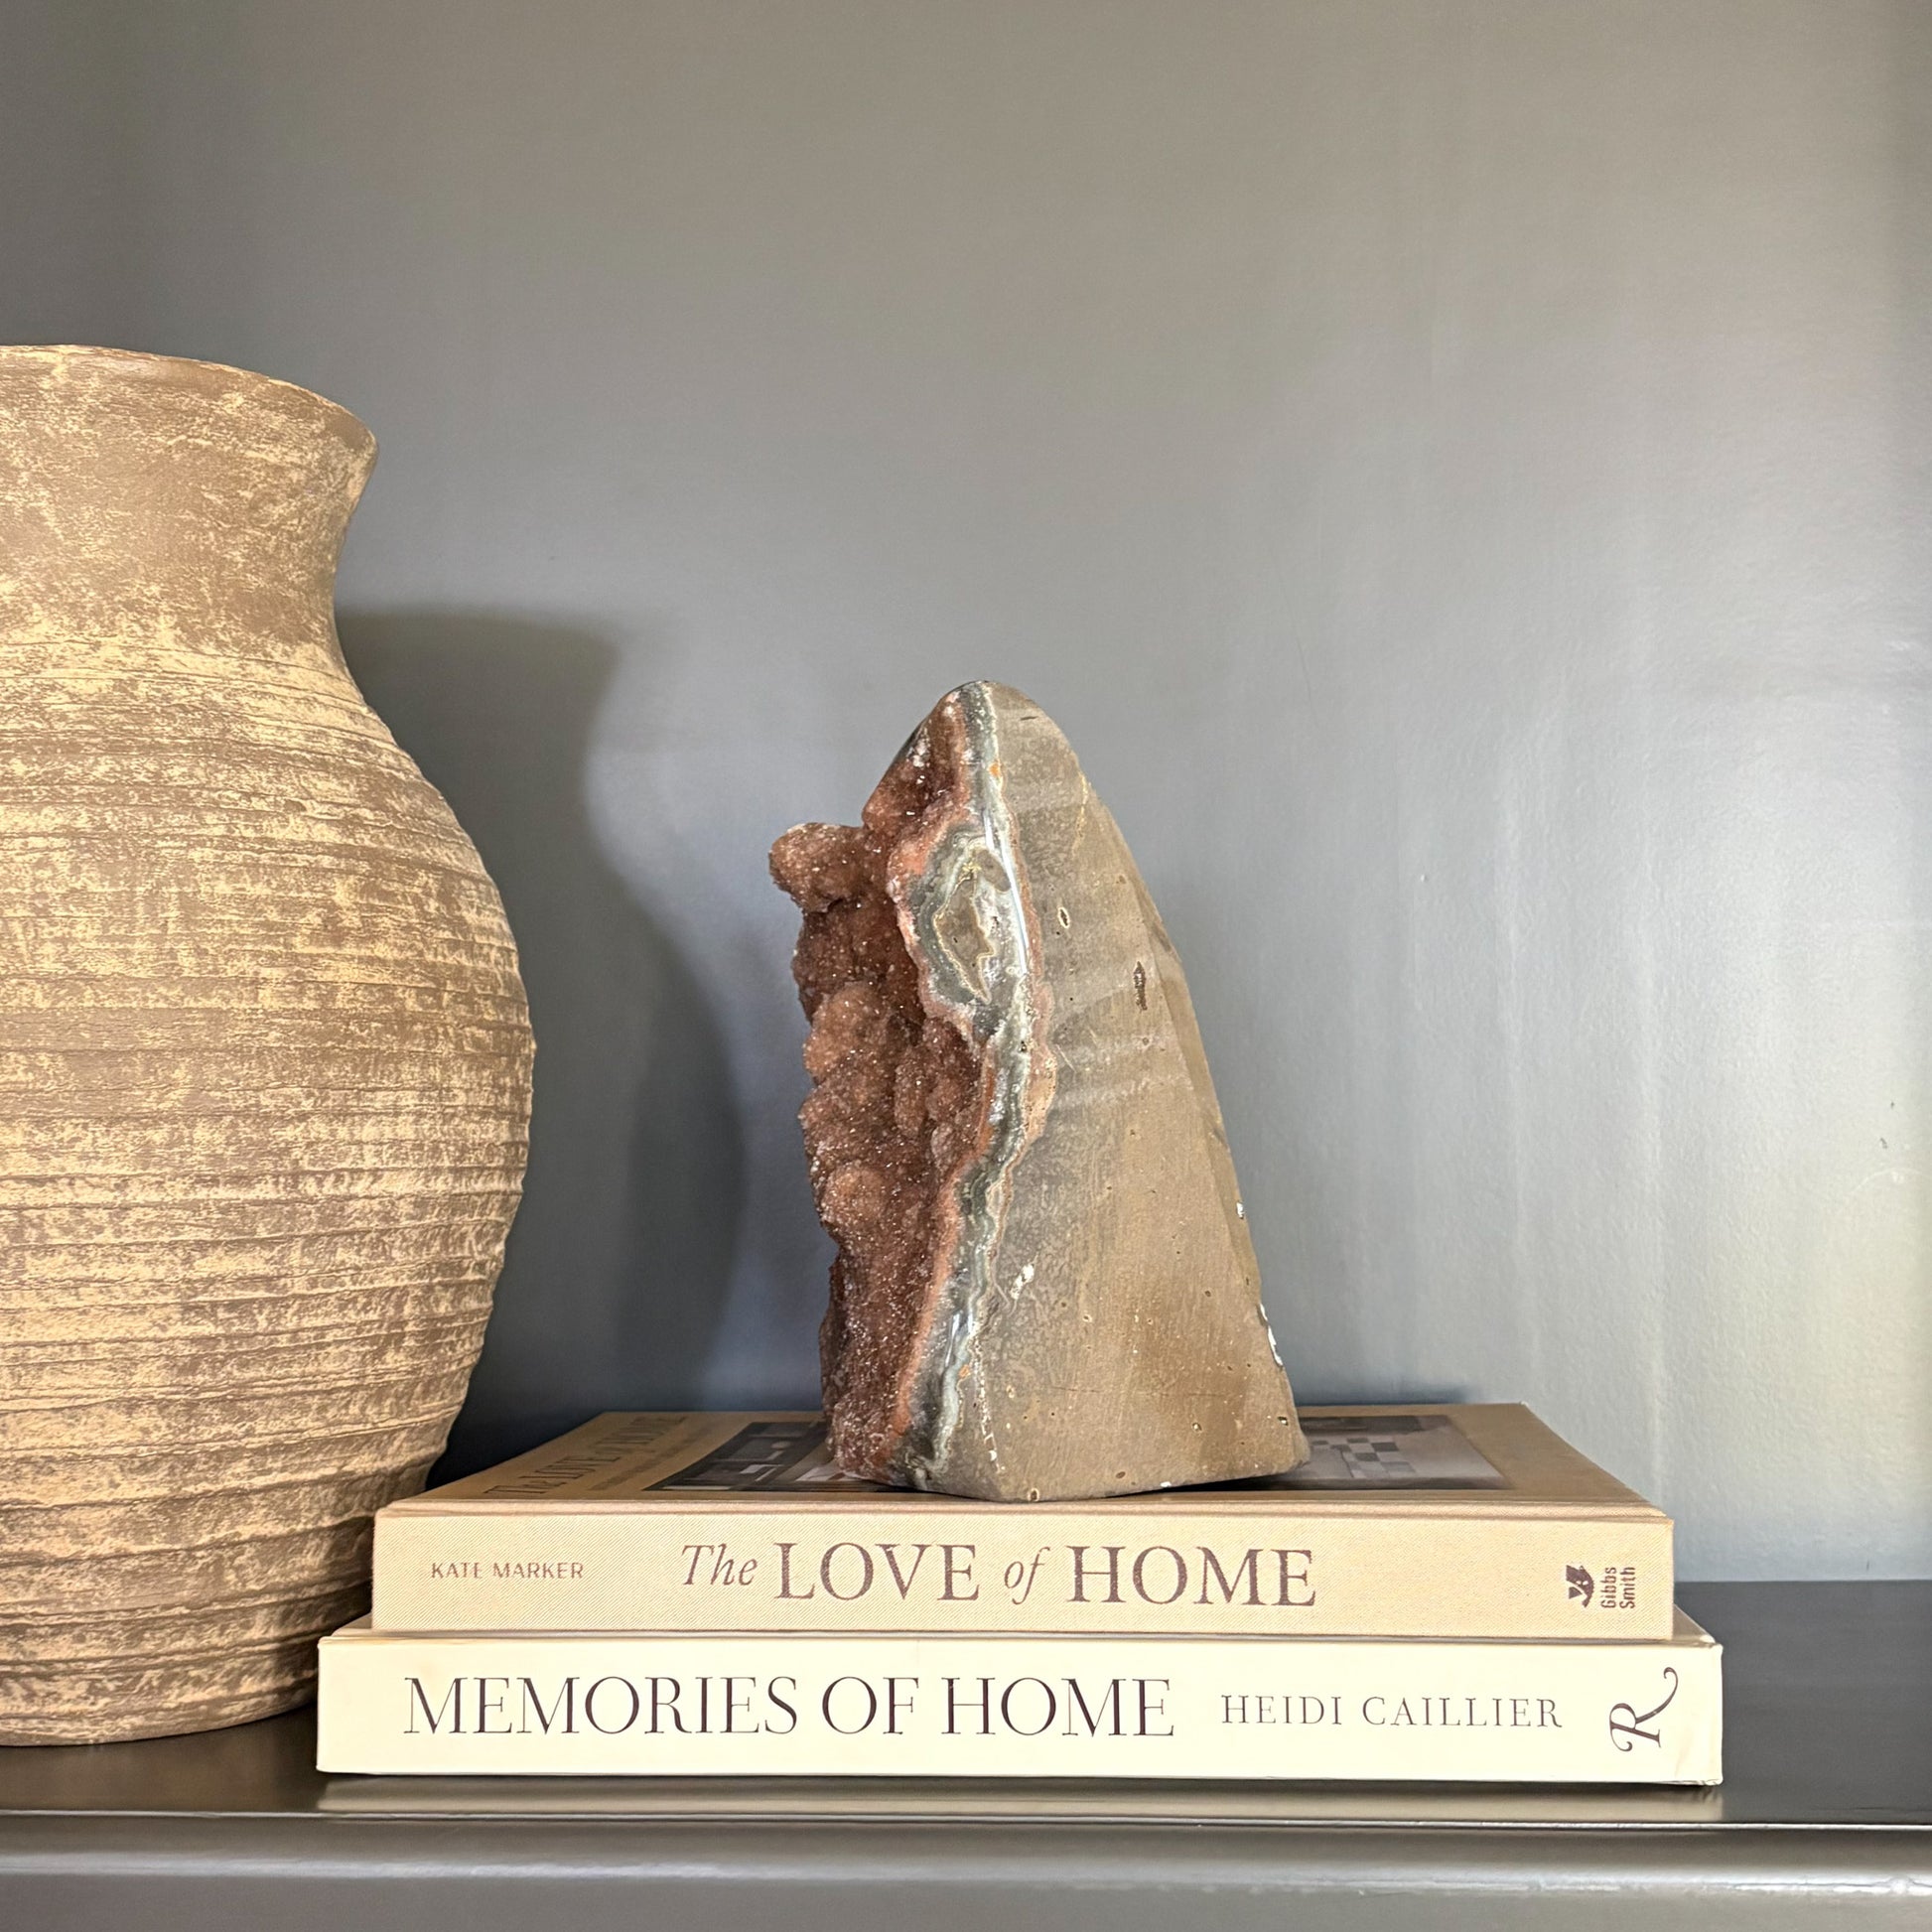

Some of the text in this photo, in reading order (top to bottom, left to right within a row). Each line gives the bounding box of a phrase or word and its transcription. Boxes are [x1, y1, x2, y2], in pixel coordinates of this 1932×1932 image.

[431, 1562, 584, 1580] KATE MARKER
[681, 1543, 1314, 1605] The LOVE of HOME
[1601, 1568, 1616, 1608] Gibbs
[1619, 1568, 1635, 1608] Smith
[404, 1677, 1173, 1736] MEMORIES OF HOME
[1221, 1695, 1562, 1727] HEIDI CAILLIER
[1608, 1667, 1678, 1751] R
